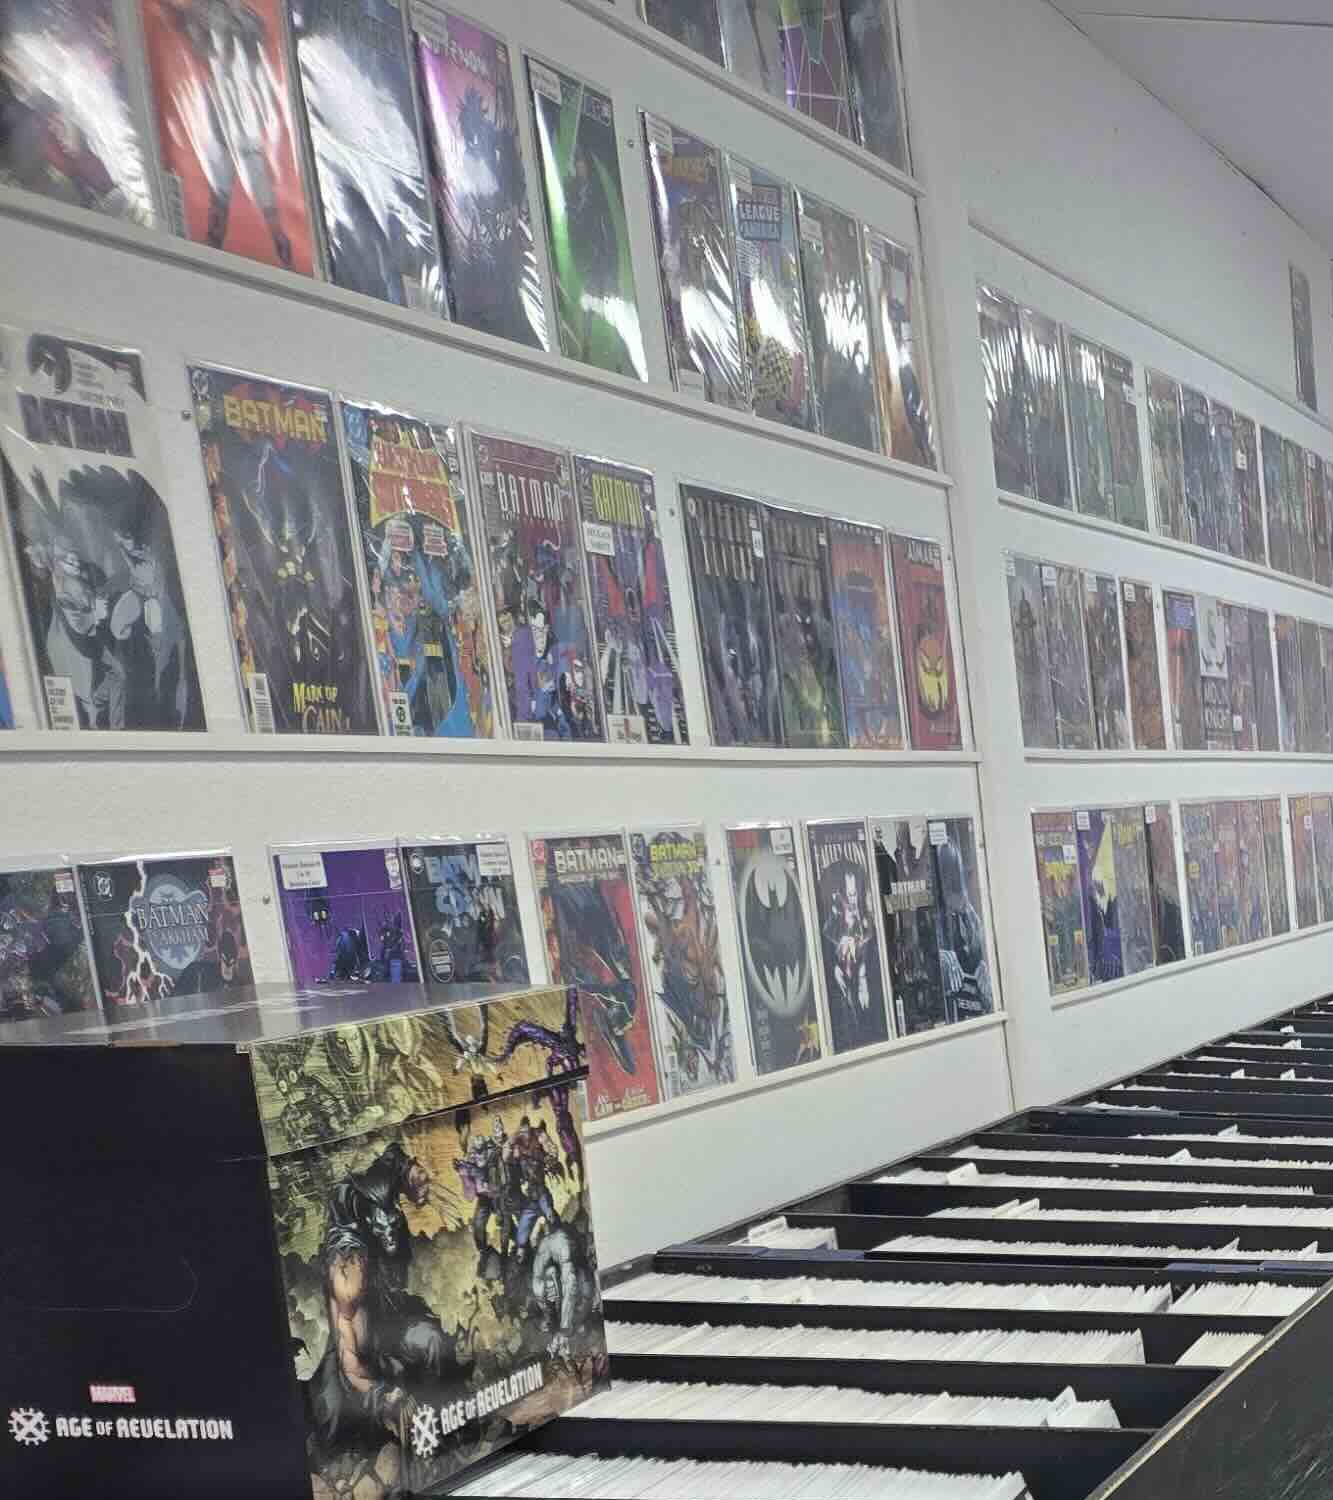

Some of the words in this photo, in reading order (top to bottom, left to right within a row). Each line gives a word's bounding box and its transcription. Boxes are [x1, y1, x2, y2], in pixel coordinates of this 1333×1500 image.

[224, 392, 328, 442] BATMAN
[497, 470, 565, 520] BATMAN
[554, 847, 619, 874] BATMAN
[137, 901, 210, 932] BATMAN
[89, 1385, 136, 1403] MARVEL
[440, 1400, 466, 1436] AGE
[465, 1397, 477, 1420] OF
[476, 1361, 545, 1417] REVELATION
[55, 1417, 93, 1438] AGE
[96, 1420, 114, 1436] OF
[116, 1417, 234, 1440] REVELATION
